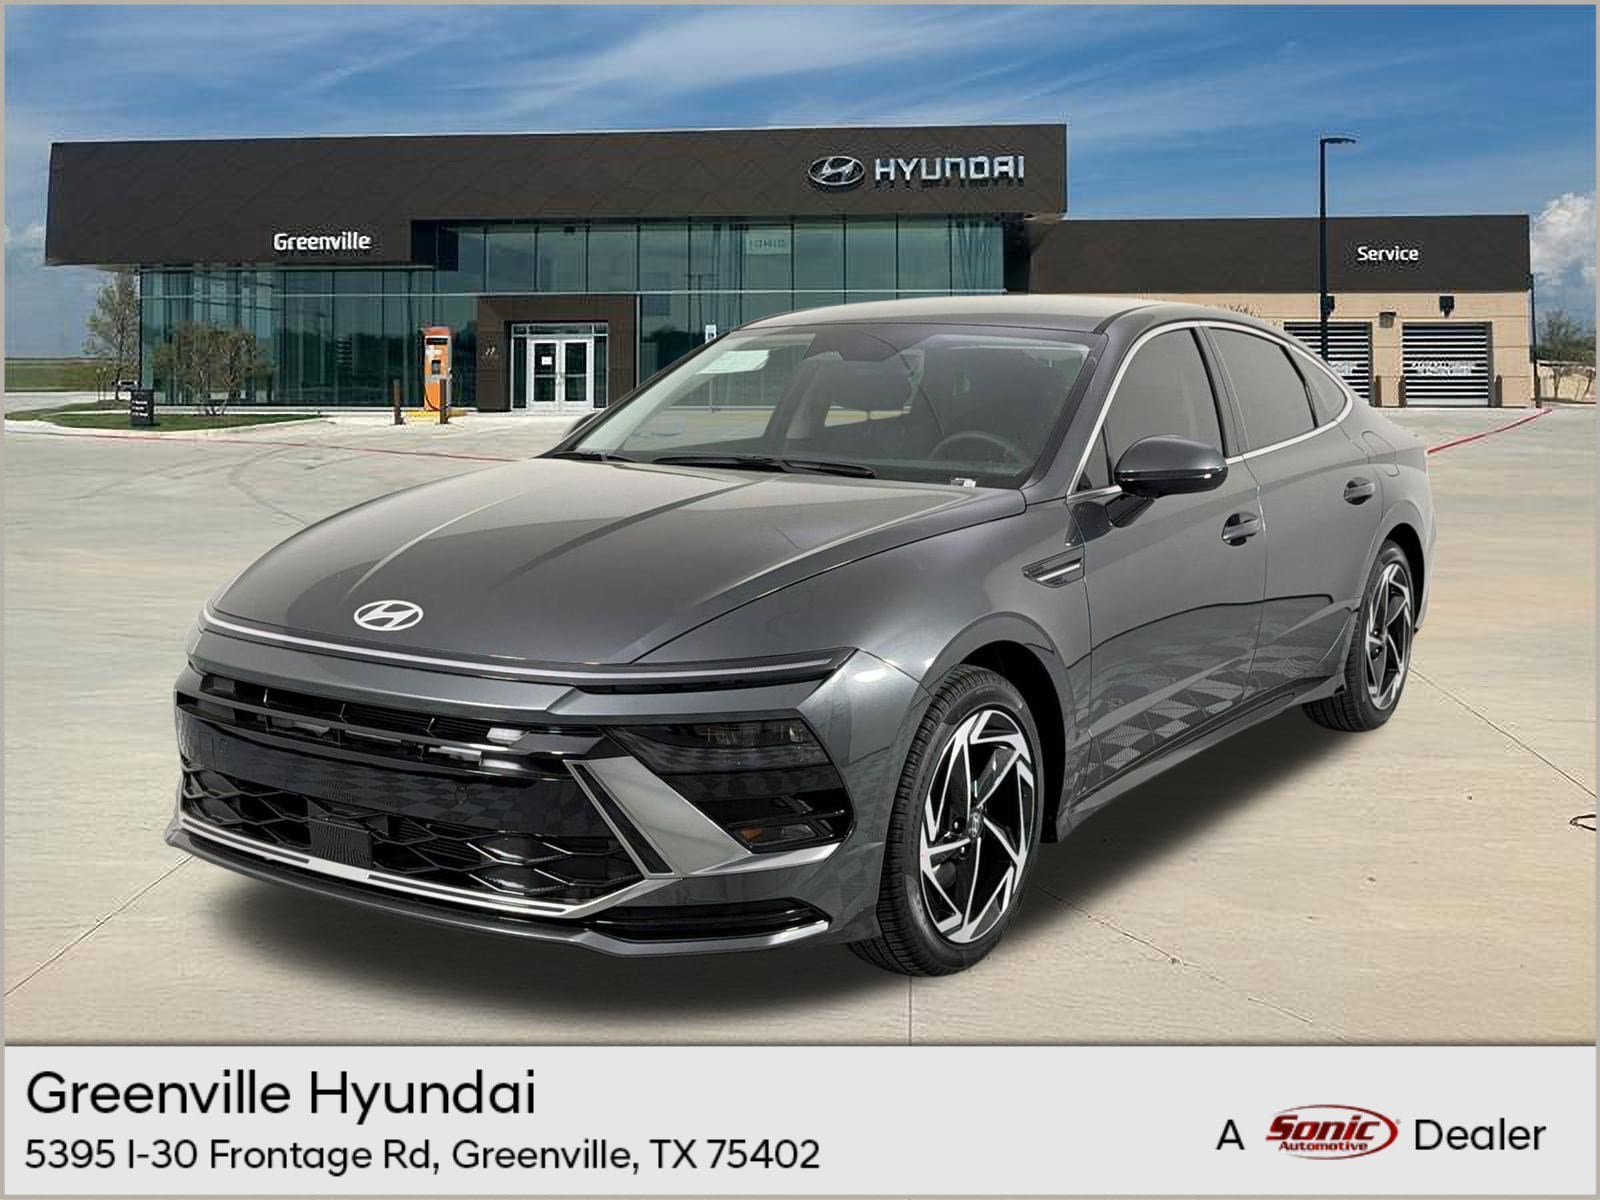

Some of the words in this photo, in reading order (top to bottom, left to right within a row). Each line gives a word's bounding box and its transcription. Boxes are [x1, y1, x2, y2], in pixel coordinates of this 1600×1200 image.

[875, 155, 1025, 181] HYUNDAI
[273, 231, 372, 251] Greenville
[1357, 245, 1420, 262] Service
